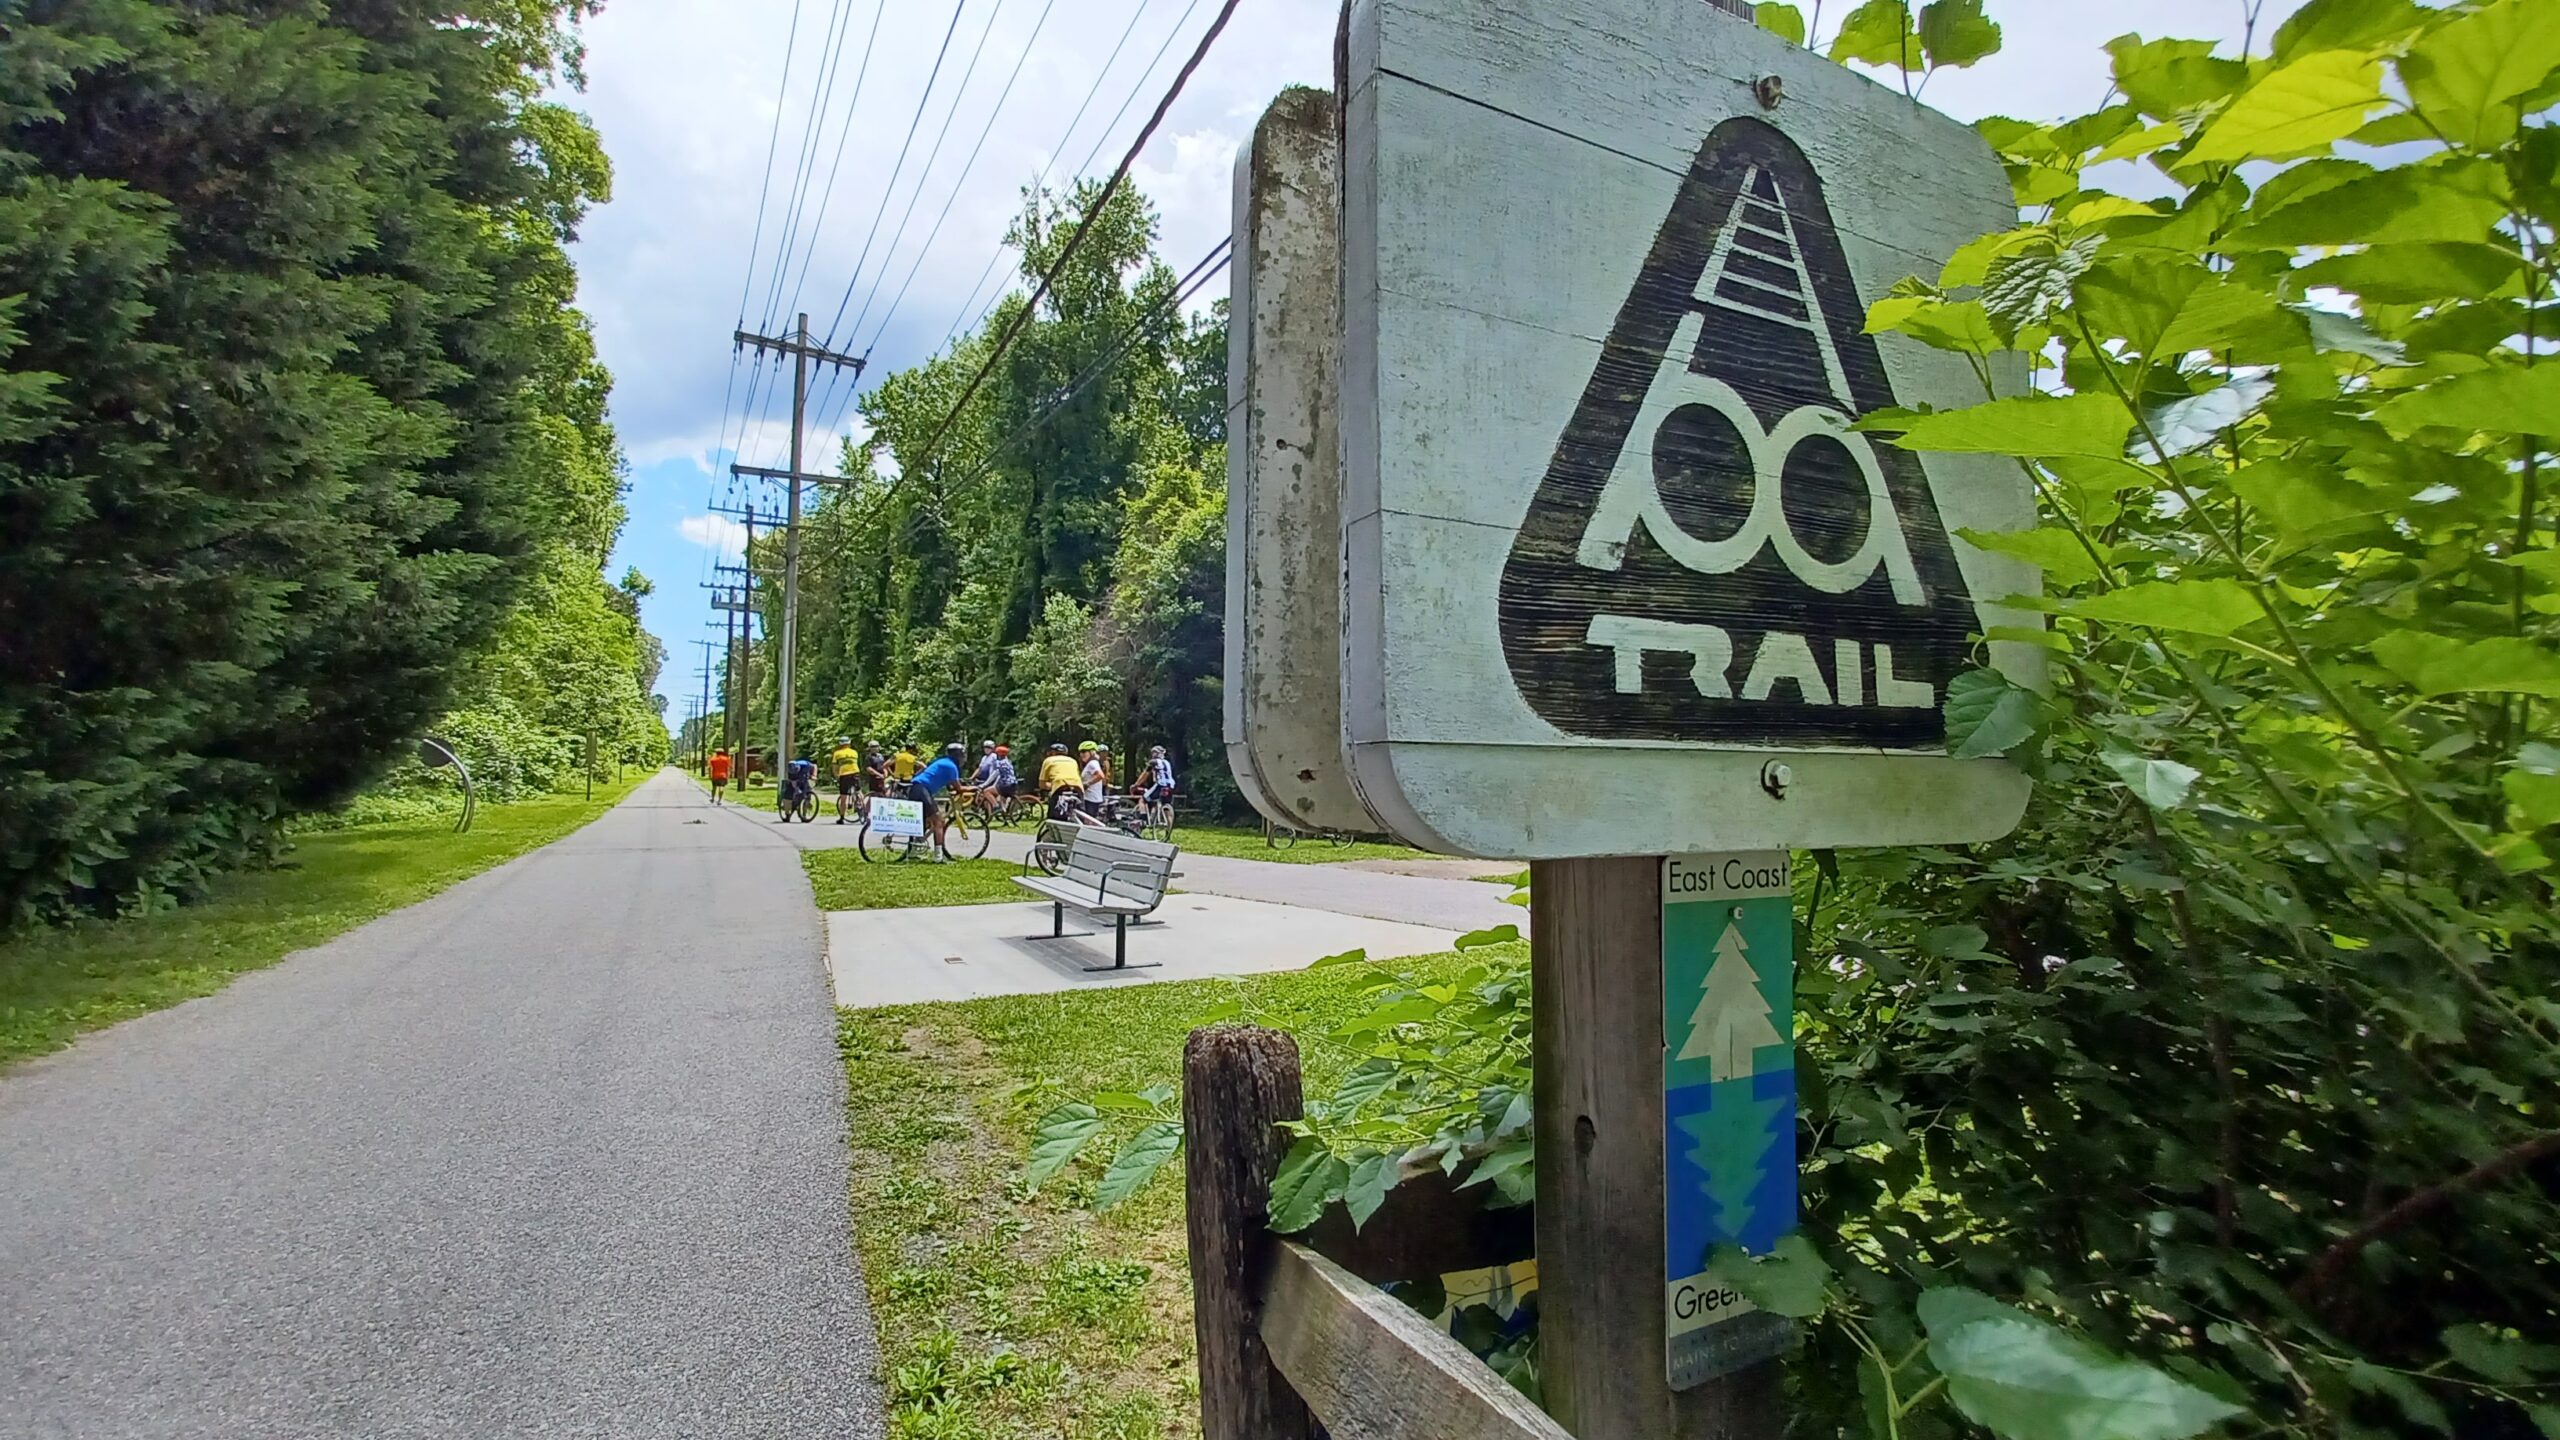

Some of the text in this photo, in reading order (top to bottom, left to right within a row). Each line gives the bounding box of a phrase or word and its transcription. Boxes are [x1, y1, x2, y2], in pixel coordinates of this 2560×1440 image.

[1585, 613, 1934, 709] TRAIL
[1669, 859, 1788, 892] East Coast
[1673, 1345, 1715, 1370] MAINE
